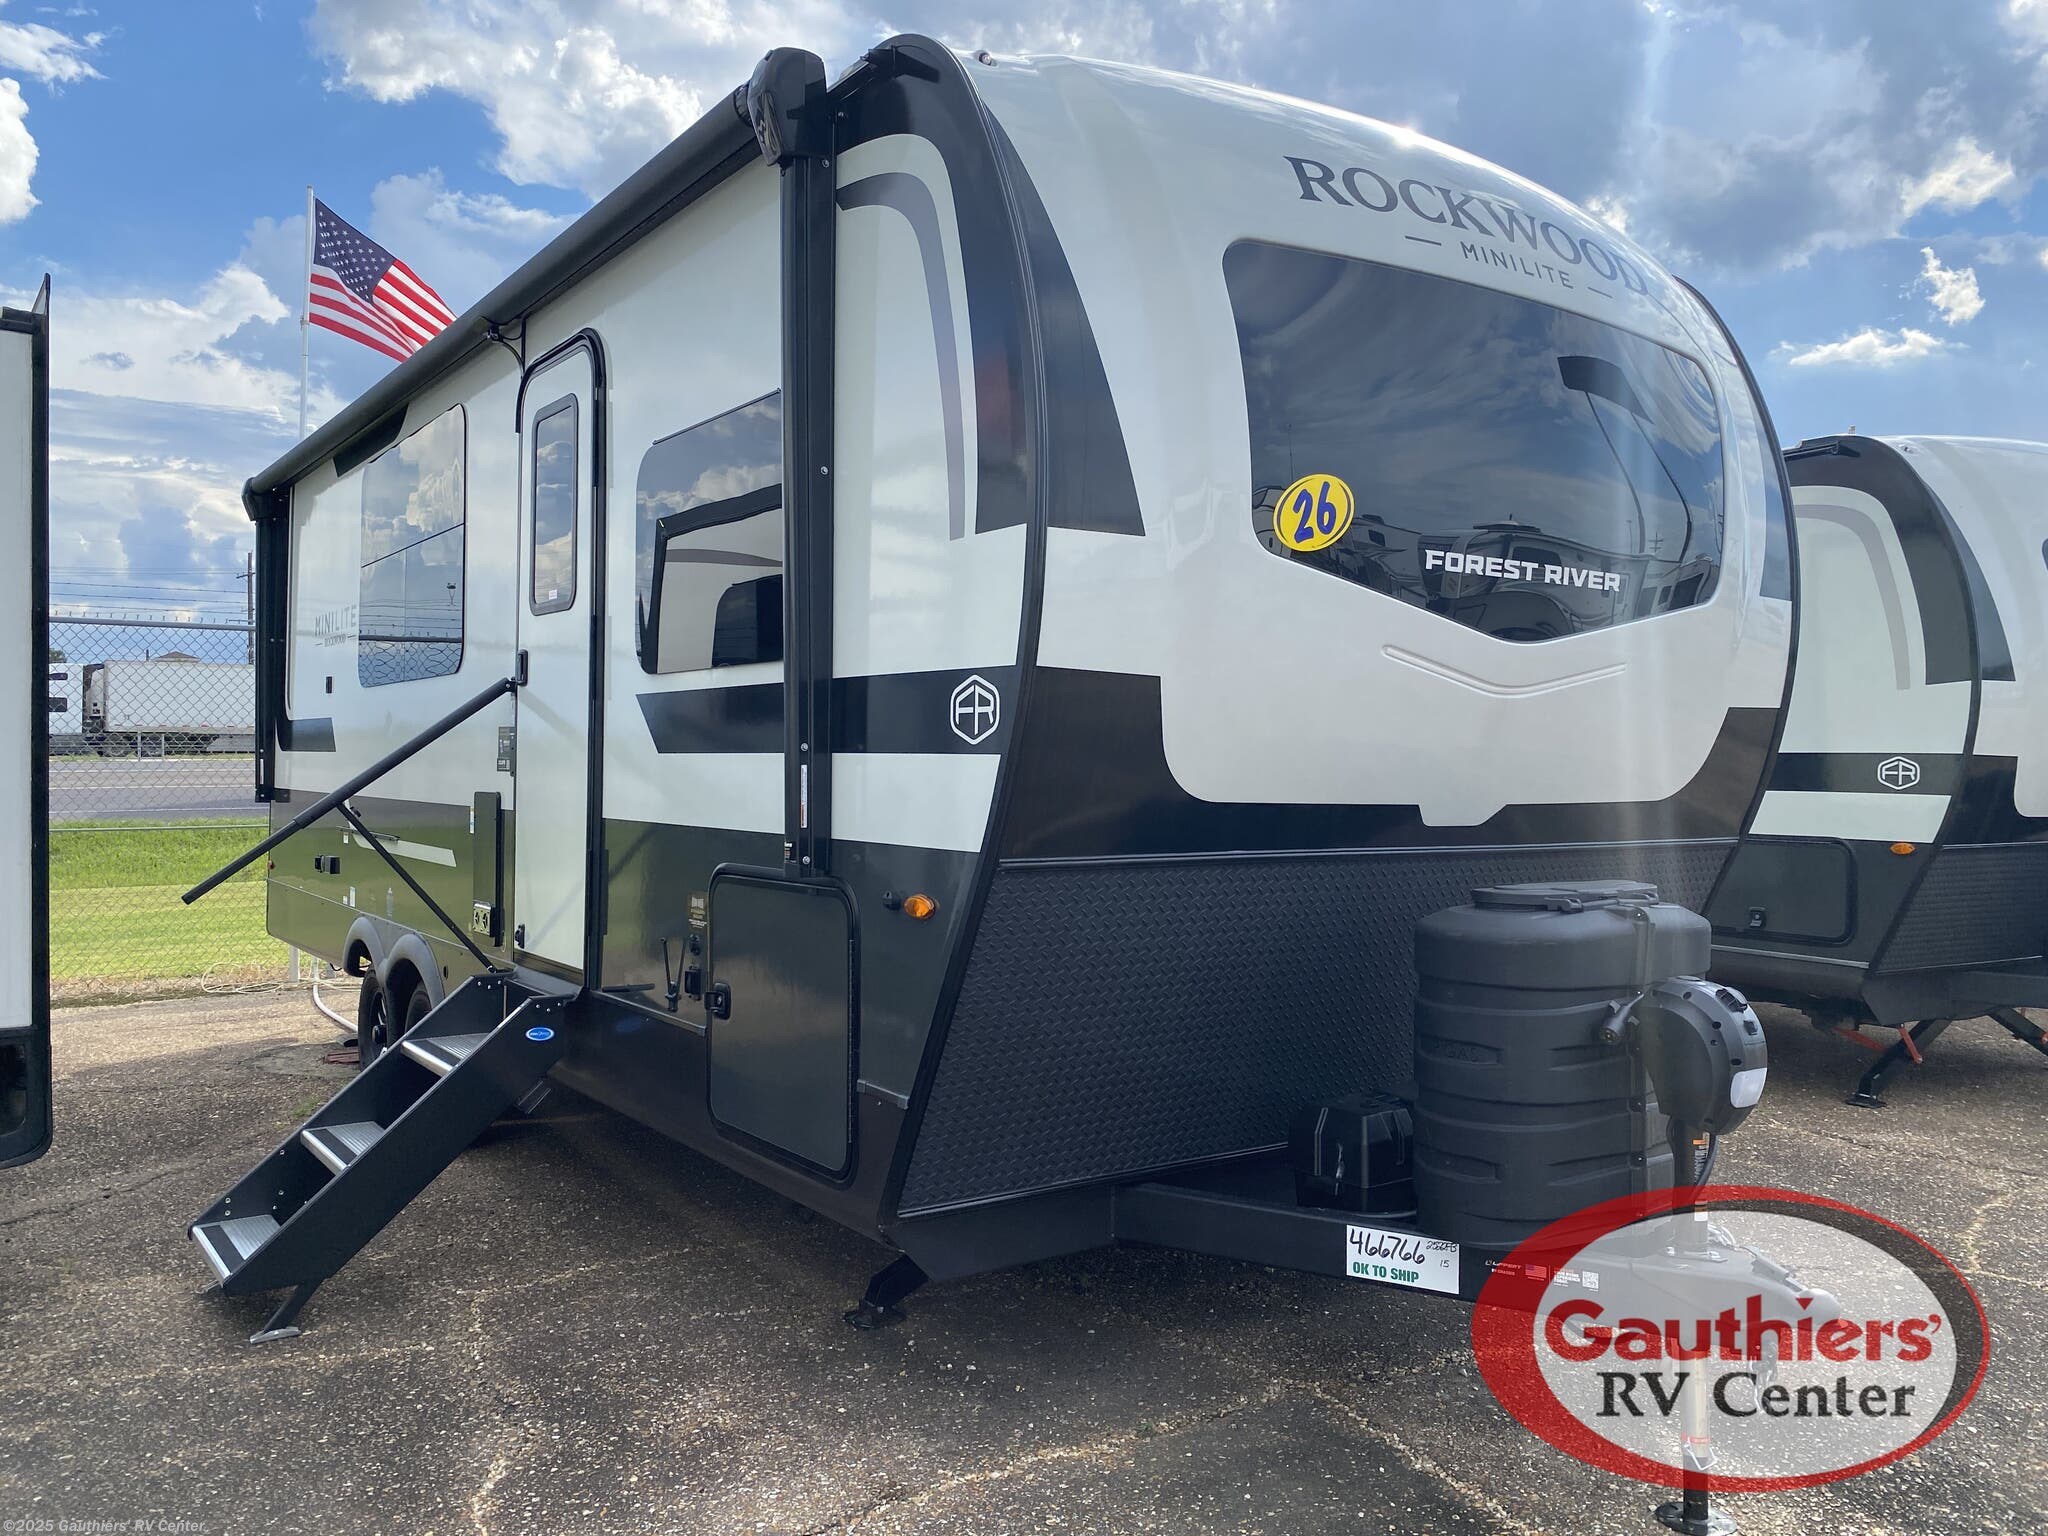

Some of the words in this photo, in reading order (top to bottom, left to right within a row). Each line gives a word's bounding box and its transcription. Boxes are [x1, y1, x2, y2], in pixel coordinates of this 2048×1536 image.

[1282, 155, 1649, 296] ROCKWOOD
[1459, 240, 1574, 290] MINILITE
[1293, 481, 1337, 544] 26
[1424, 549, 1539, 582] FOREST
[1544, 564, 1621, 593] RIVER
[1350, 1228, 1425, 1265] 466766
[1352, 1261, 1369, 1275] OK
[1372, 1264, 1387, 1278] TO
[1390, 1267, 1419, 1283] SHIP
